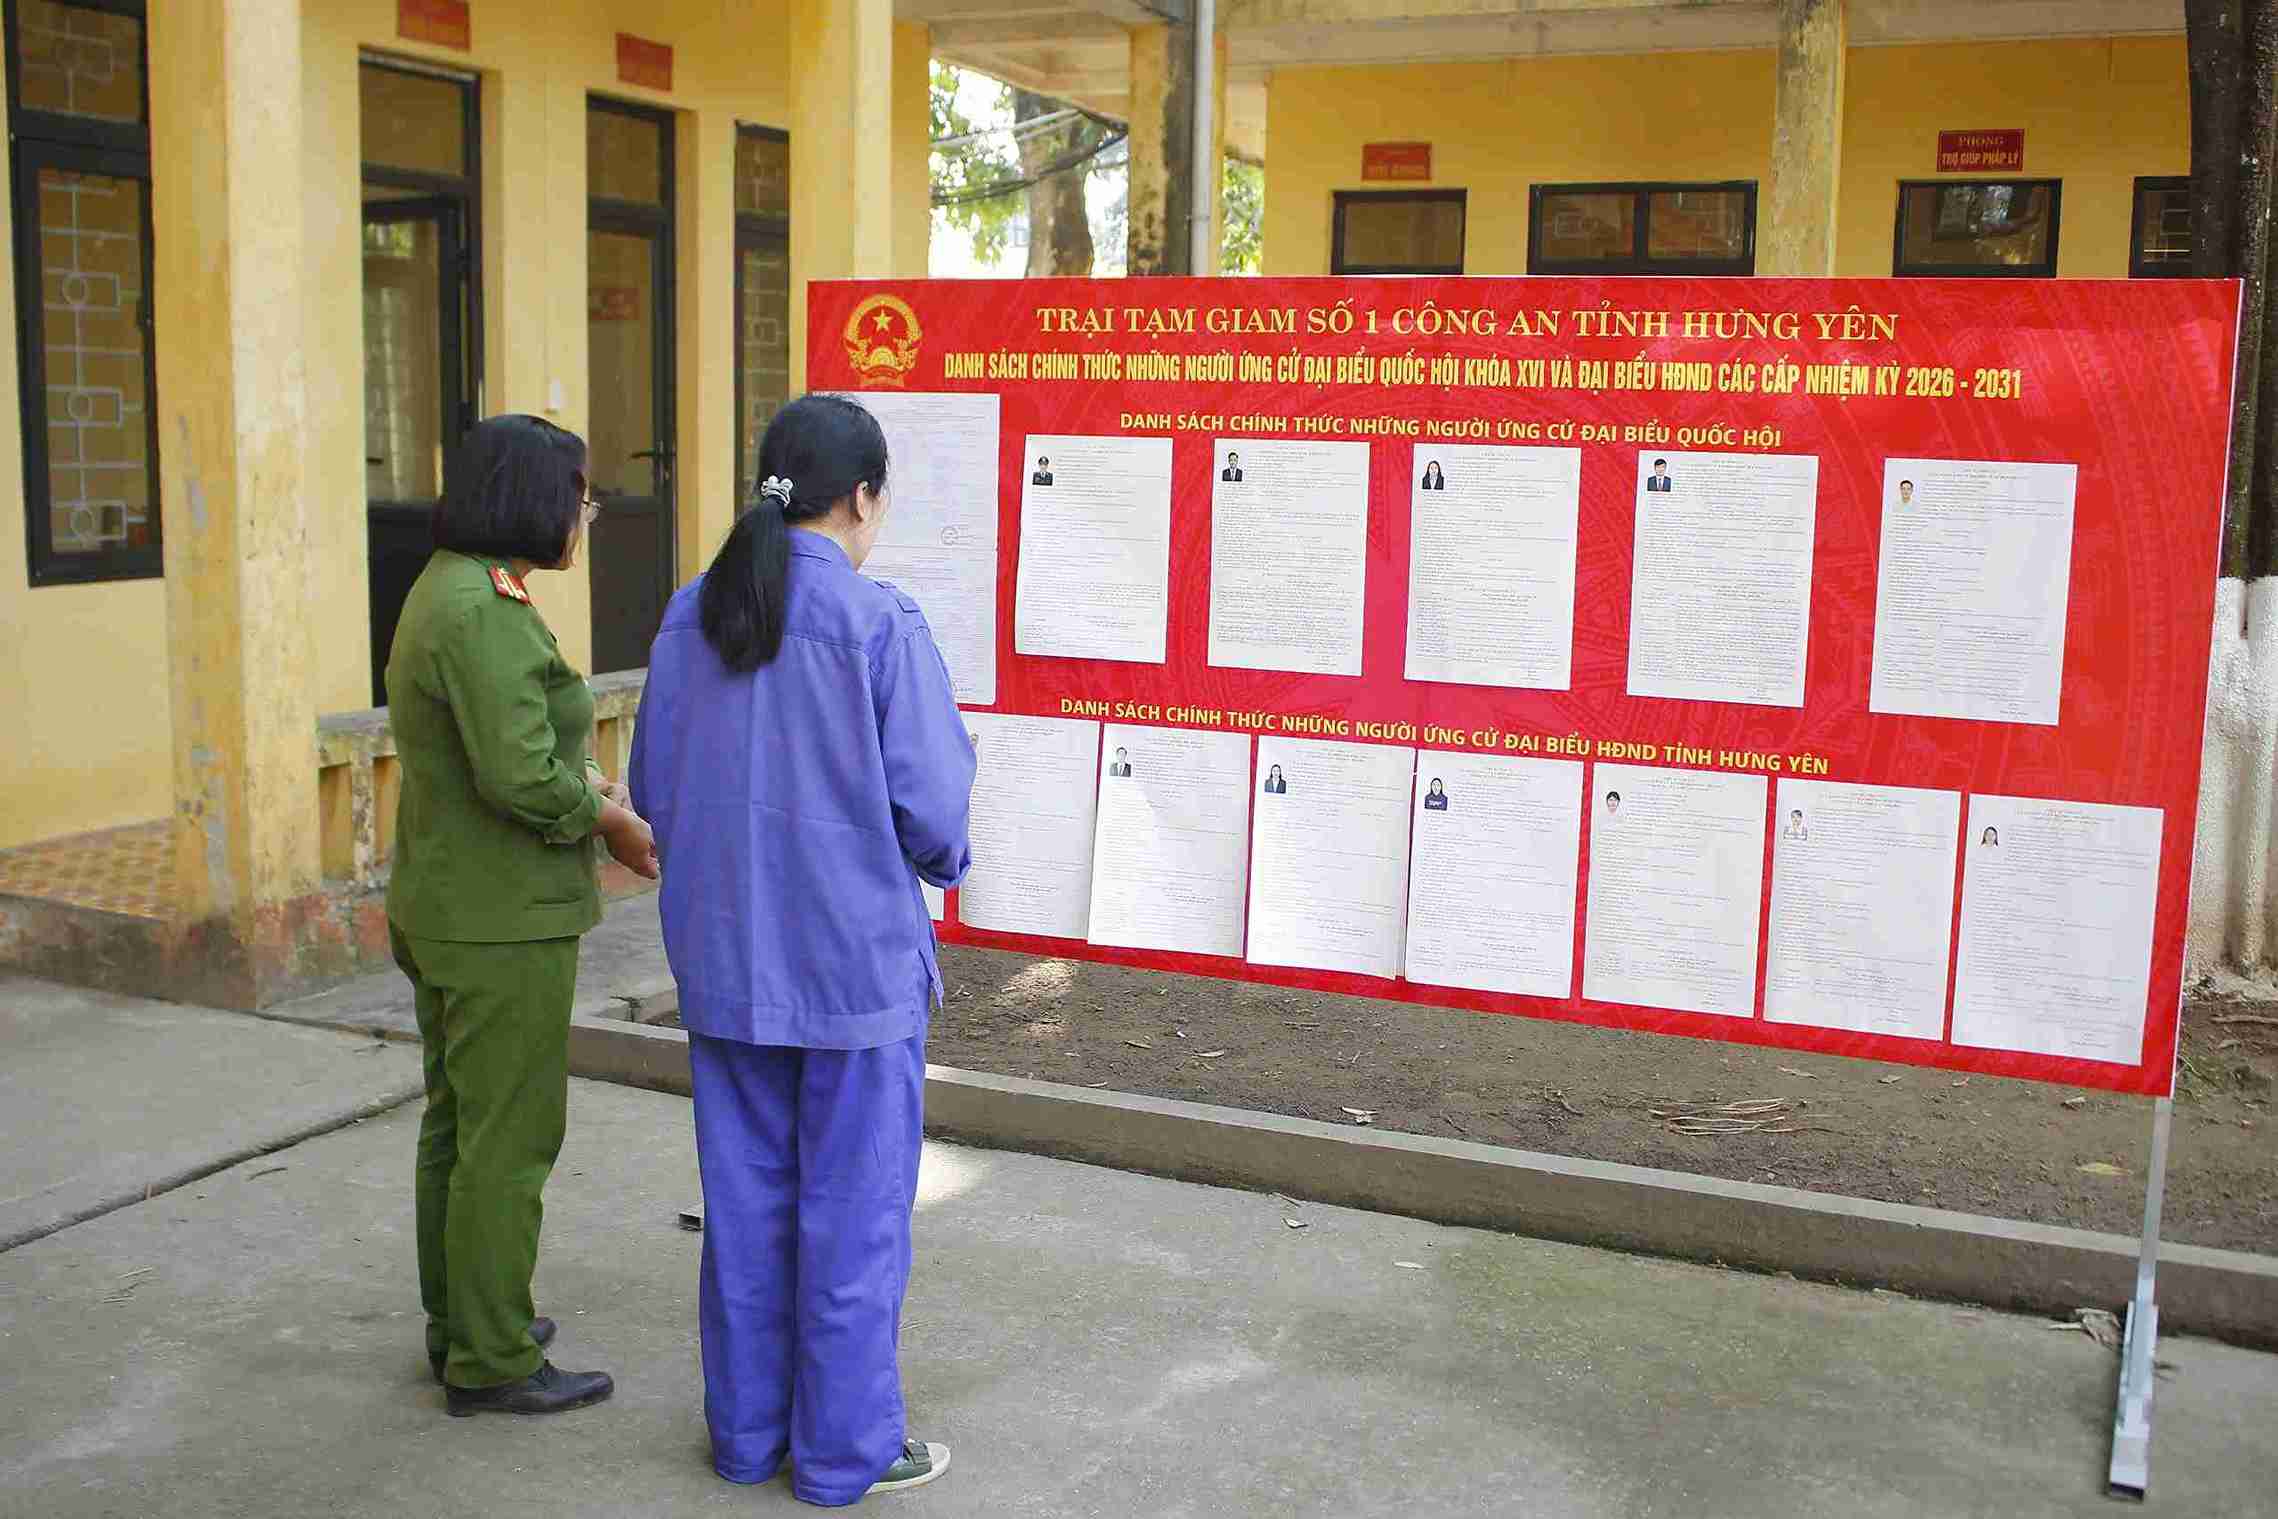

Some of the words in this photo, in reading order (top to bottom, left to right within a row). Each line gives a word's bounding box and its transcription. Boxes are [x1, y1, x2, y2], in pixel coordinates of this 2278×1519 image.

[1036, 307, 1115, 339] TRẠI
[1123, 307, 1197, 339] TẠM
[1206, 307, 1297, 333] GIAM
[1307, 298, 1354, 334] SỐ
[1365, 309, 1379, 334] 1
[1392, 300, 1498, 337] CÔNG
[1507, 309, 1561, 336] AN
[1571, 300, 1670, 337] TỈNH
[1682, 308, 1801, 340] HƯNG
[1812, 304, 1899, 340] YÊN
[944, 352, 984, 379] DANH
[988, 347, 1028, 379] SÁCH
[1032, 348, 1078, 380] CHÍNH
[1083, 349, 1121, 380] THỨC
[1126, 349, 1180, 381] NHỮNG
[1185, 348, 1234, 382] NGƯỜI
[1239, 350, 1272, 383] ỨNG
[1304, 356, 1332, 391] ĐẠI
[1336, 346, 1375, 384] BIỂU
[1380, 348, 1425, 388] QUỐC
[1431, 351, 1459, 391] HỘI
[1464, 353, 1511, 387] KHÓA
[1517, 359, 1545, 387] XVI
[1551, 354, 1573, 388] VÀ
[1578, 360, 1608, 395] ĐẠI
[1614, 350, 1656, 390] BIỂU
[1661, 362, 1713, 391] HĐND
[1718, 357, 1755, 392] CÁC
[1762, 353, 1799, 393] CẤP
[1805, 359, 1870, 401] NHIỆM
[1875, 360, 1900, 396] KỲ
[1905, 366, 1954, 397] 2026
[1973, 368, 2022, 399] 2031
[1120, 413, 1171, 430] DANH
[1177, 411, 1224, 431] SÁCH
[1230, 411, 1287, 432] CHÍNH
[1294, 413, 1344, 434] THỨC
[1350, 416, 1420, 436] NHỮNG
[1426, 418, 1490, 438] NGƯỜI
[1497, 417, 1540, 440] ỨNG
[1580, 424, 1617, 445] ĐẠI
[1624, 418, 1670, 444] BIỂU
[1676, 422, 1736, 447] QUỐC
[1743, 425, 1782, 451] HỘI
[1060, 698, 1110, 717] DANH
[1115, 700, 1160, 721] SÁCH
[1166, 704, 1221, 727] CHÍNH
[1227, 709, 1275, 731] THỨC
[1282, 714, 1349, 736] NHỮNG
[1355, 720, 1417, 742] NGƯỜI
[1423, 722, 1465, 745] ỨNG
[1504, 732, 1539, 755] ĐẠI
[1546, 731, 1591, 756] BIỂU
[1597, 742, 1658, 761] HĐND
[1663, 741, 1712, 765] TỈNH
[1719, 751, 1781, 772] HƯNG
[1788, 751, 1829, 775] YÊN
